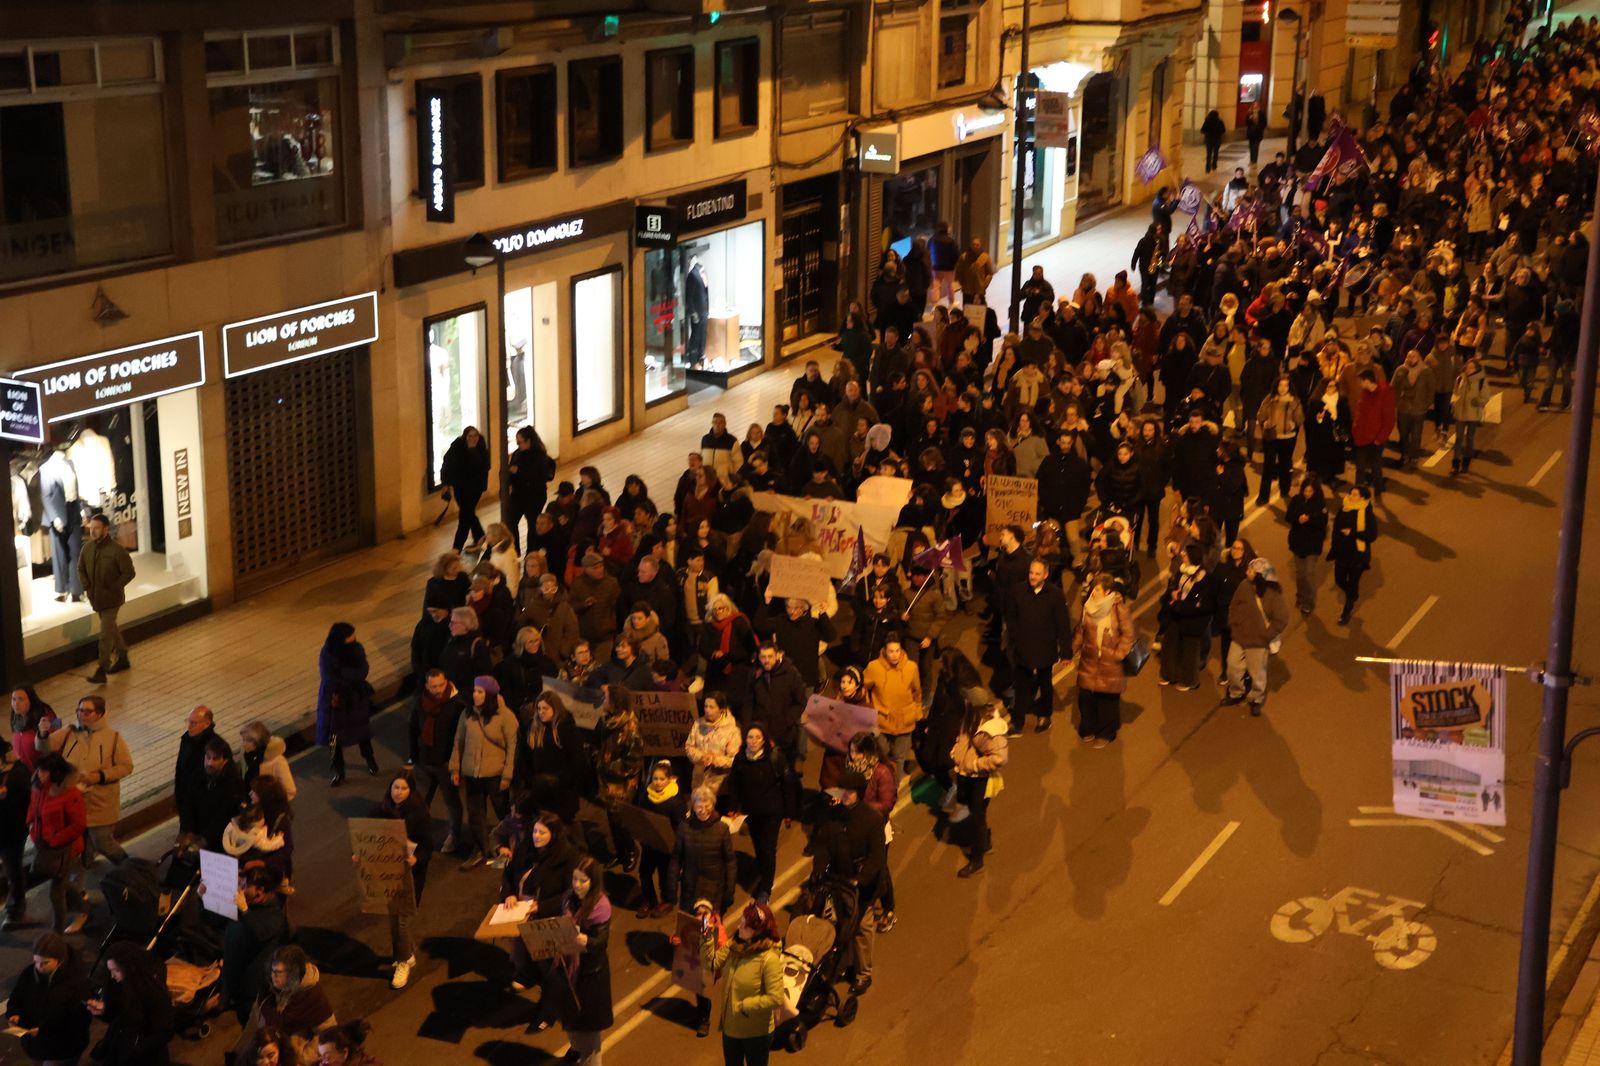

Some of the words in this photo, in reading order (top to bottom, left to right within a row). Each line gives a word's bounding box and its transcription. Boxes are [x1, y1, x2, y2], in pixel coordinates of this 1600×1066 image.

[686, 194, 735, 221] FLORENTINO
[526, 219, 584, 248] DOMINGUEZ
[637, 231, 671, 241] FLORENTINO
[246, 325, 277, 348] LION
[280, 321, 298, 339] OF
[300, 308, 355, 335] PORCHES
[288, 336, 318, 352] LONDON
[43, 371, 81, 396] LION
[84, 364, 108, 386] OF
[110, 350, 177, 380] PORCHES
[7, 389, 28, 402] LION
[95, 381, 132, 400] LONDON
[12, 401, 24, 412] OF
[0, 410, 39, 425] PORCHES
[176, 452, 187, 466] IN
[177, 473, 190, 514] NEW
[648, 693, 661, 705] LA
[1411, 684, 1478, 714] STOCK
[638, 707, 694, 724] VERGÜENZA
